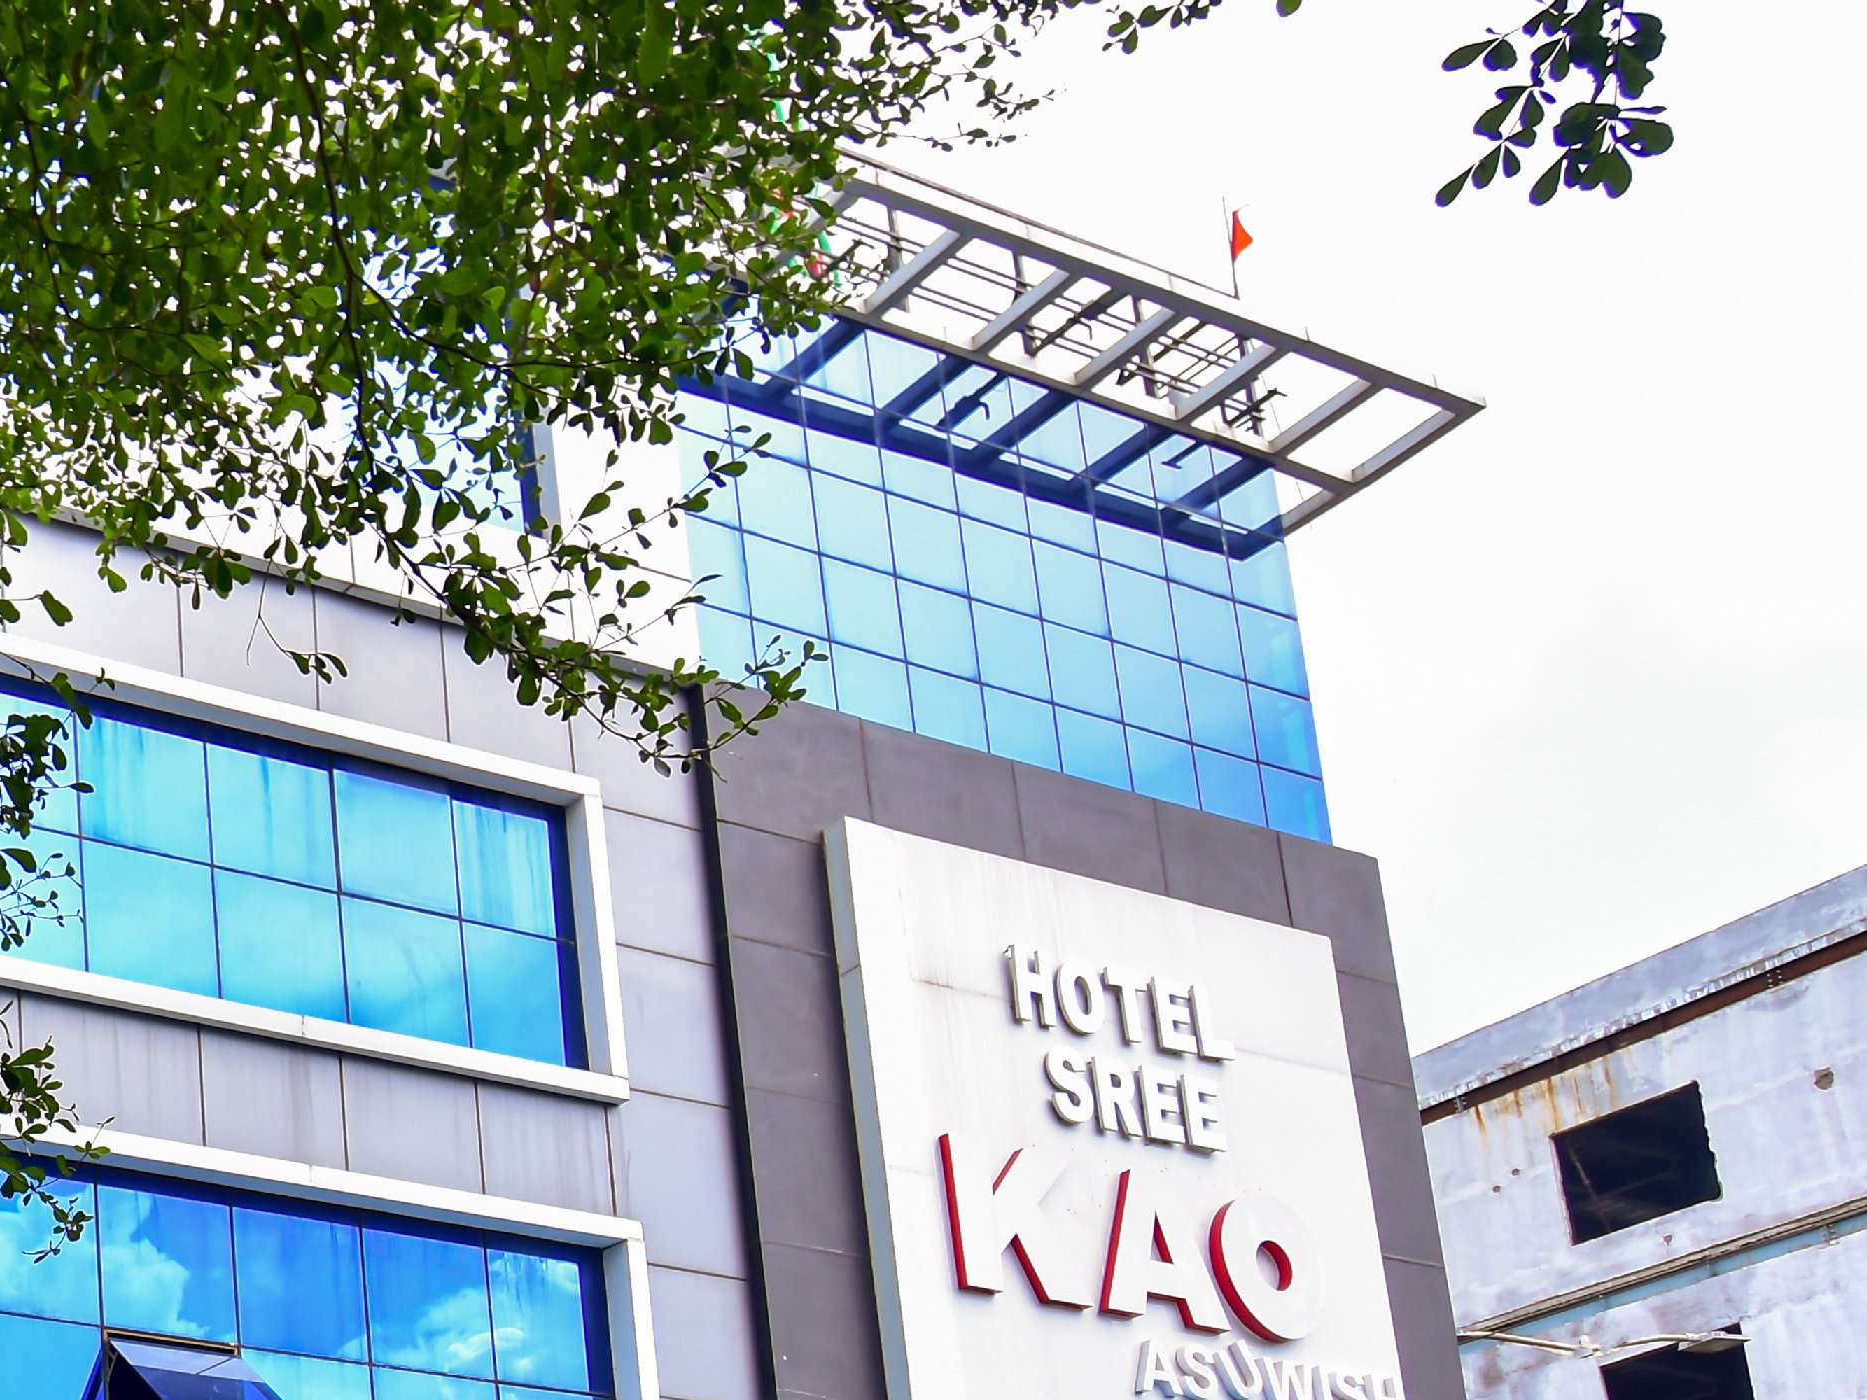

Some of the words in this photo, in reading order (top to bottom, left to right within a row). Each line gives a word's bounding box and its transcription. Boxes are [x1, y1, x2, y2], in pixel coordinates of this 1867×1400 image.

[1005, 944, 1234, 1061] HOTEL
[1044, 1050, 1226, 1152] SREE
[939, 1133, 1325, 1343] KAO
